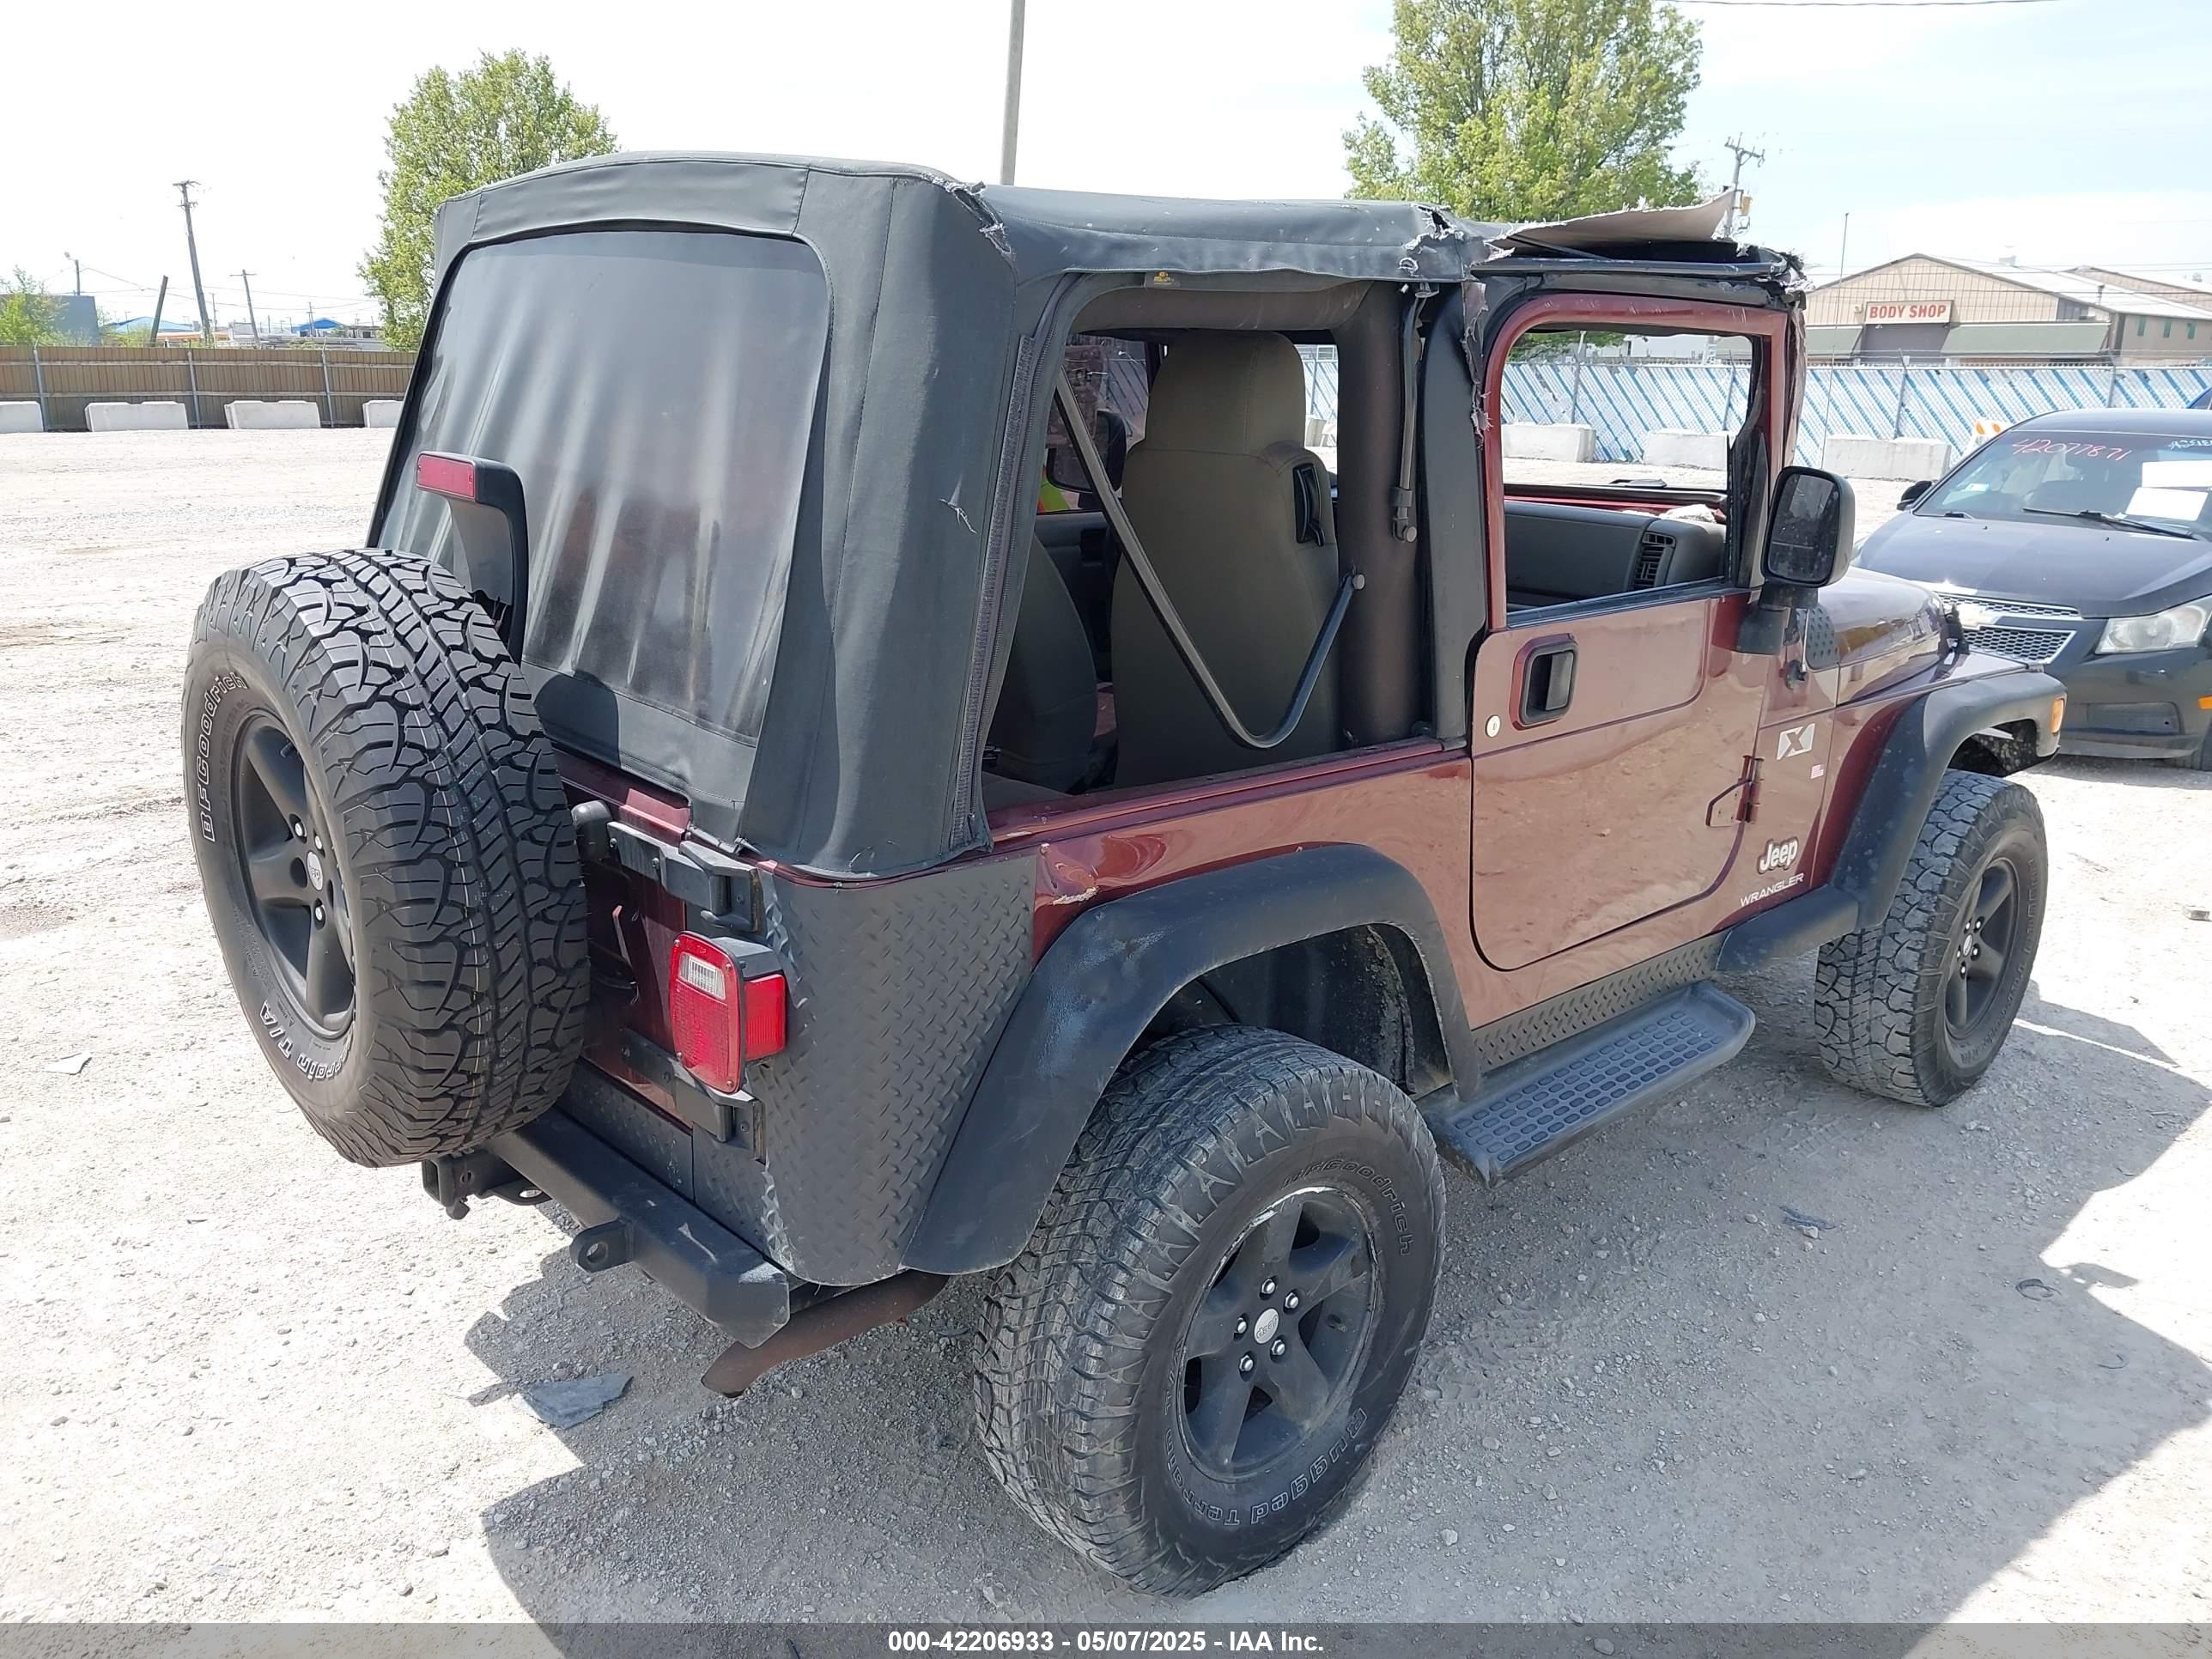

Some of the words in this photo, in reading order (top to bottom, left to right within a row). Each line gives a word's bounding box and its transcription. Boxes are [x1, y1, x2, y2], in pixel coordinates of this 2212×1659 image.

[1869, 306, 1905, 319] BODY
[1909, 304, 1947, 318] SHOP
[197, 672, 248, 842] BFGoodrich
[1740, 872, 1804, 908] WRANGLER
[1759, 836, 1799, 874] Jeep
[259, 998, 295, 1060] T/A
[1281, 1158, 1413, 1256] BFGoodrich
[1164, 1428, 1241, 1527] Terrain
[1250, 1407, 1368, 1526] Rugged
